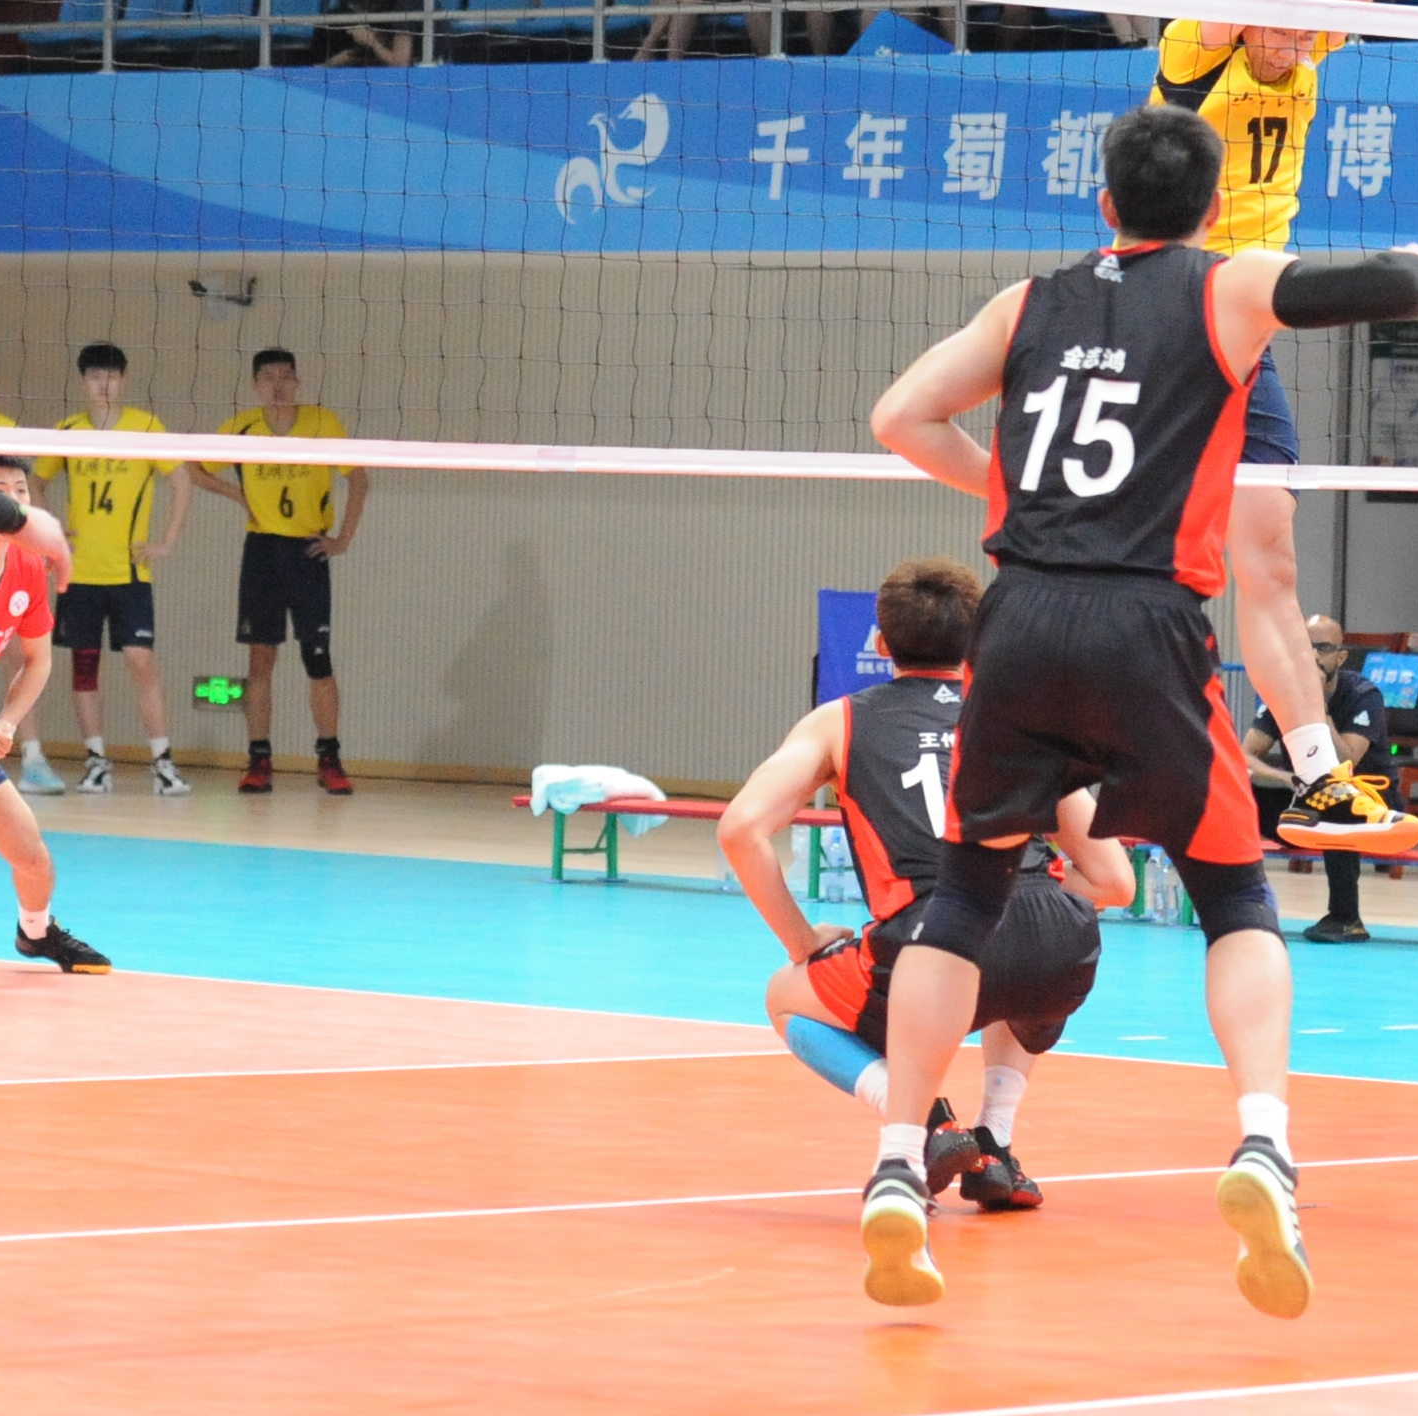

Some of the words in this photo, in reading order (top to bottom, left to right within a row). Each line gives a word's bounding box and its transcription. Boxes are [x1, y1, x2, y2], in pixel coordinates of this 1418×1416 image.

[1247, 116, 1288, 185] 17
[1019, 374, 1141, 498] 15
[88, 480, 114, 515] 14
[279, 485, 294, 520] 6
